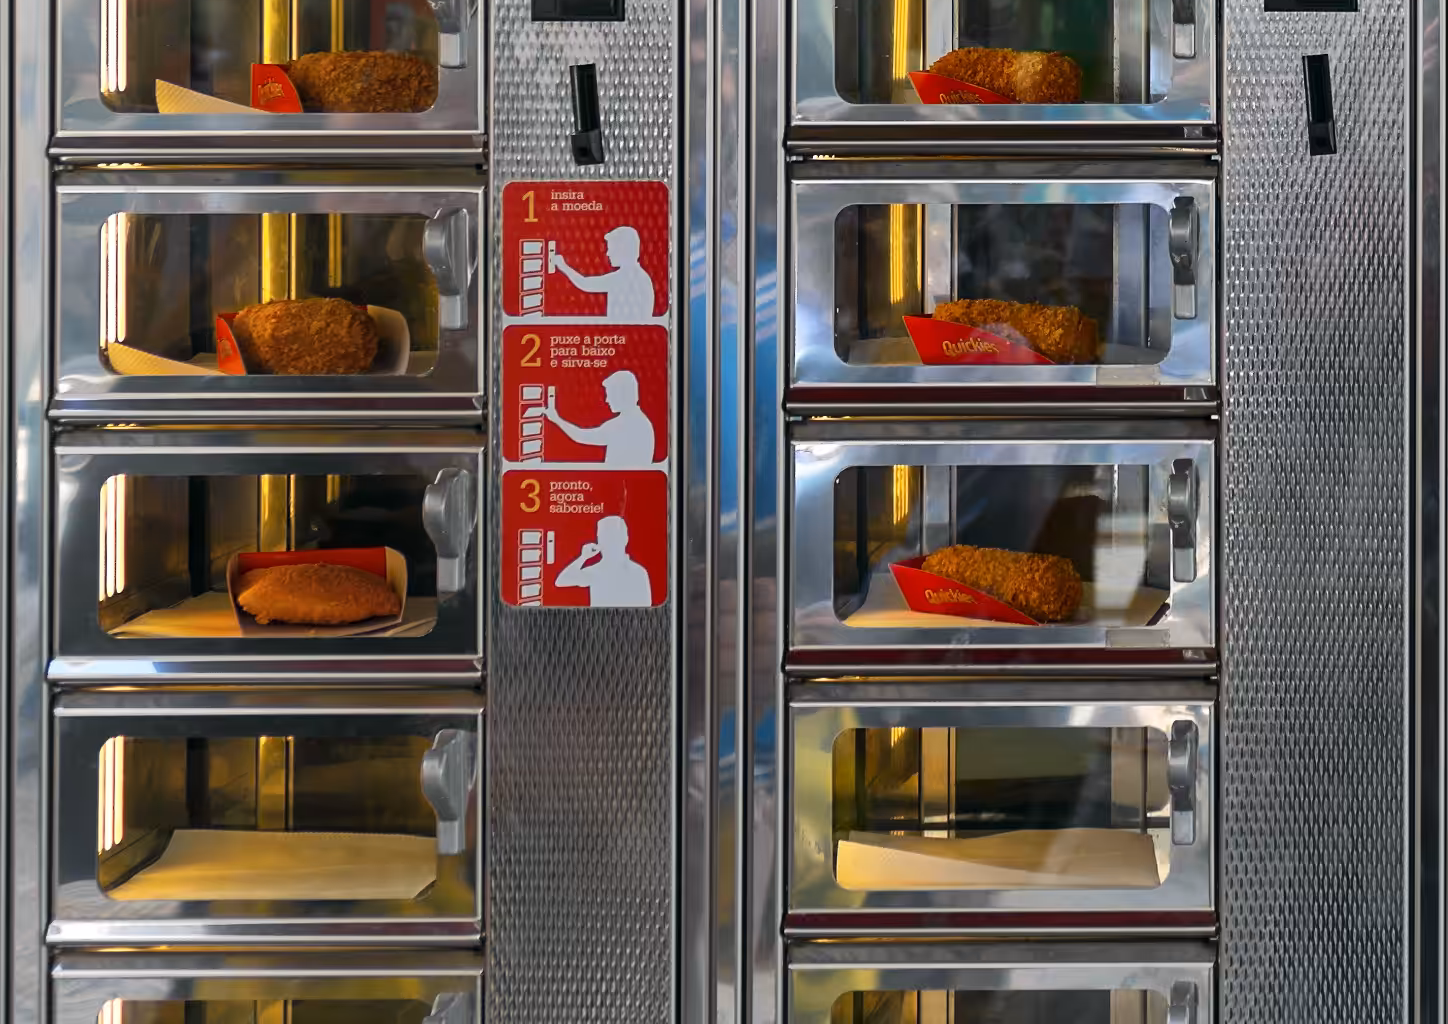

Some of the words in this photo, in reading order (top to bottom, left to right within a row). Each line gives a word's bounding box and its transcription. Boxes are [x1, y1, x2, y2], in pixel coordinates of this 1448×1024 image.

[551, 189, 584, 200] insira
[522, 190, 539, 223] 1
[550, 202, 558, 211] a
[562, 200, 603, 211] moeda
[550, 336, 580, 347] puxe
[583, 336, 591, 345] a
[593, 334, 626, 347] porta
[942, 337, 999, 356] Quickies
[520, 333, 541, 367] 2
[550, 347, 577, 358] para
[581, 345, 615, 356] baixo
[550, 359, 557, 367] e
[562, 357, 607, 368] sirva-se
[549, 480, 593, 492] pronto,
[520, 479, 540, 513] 3
[549, 493, 584, 504] agora
[549, 502, 604, 514] saboreie!
